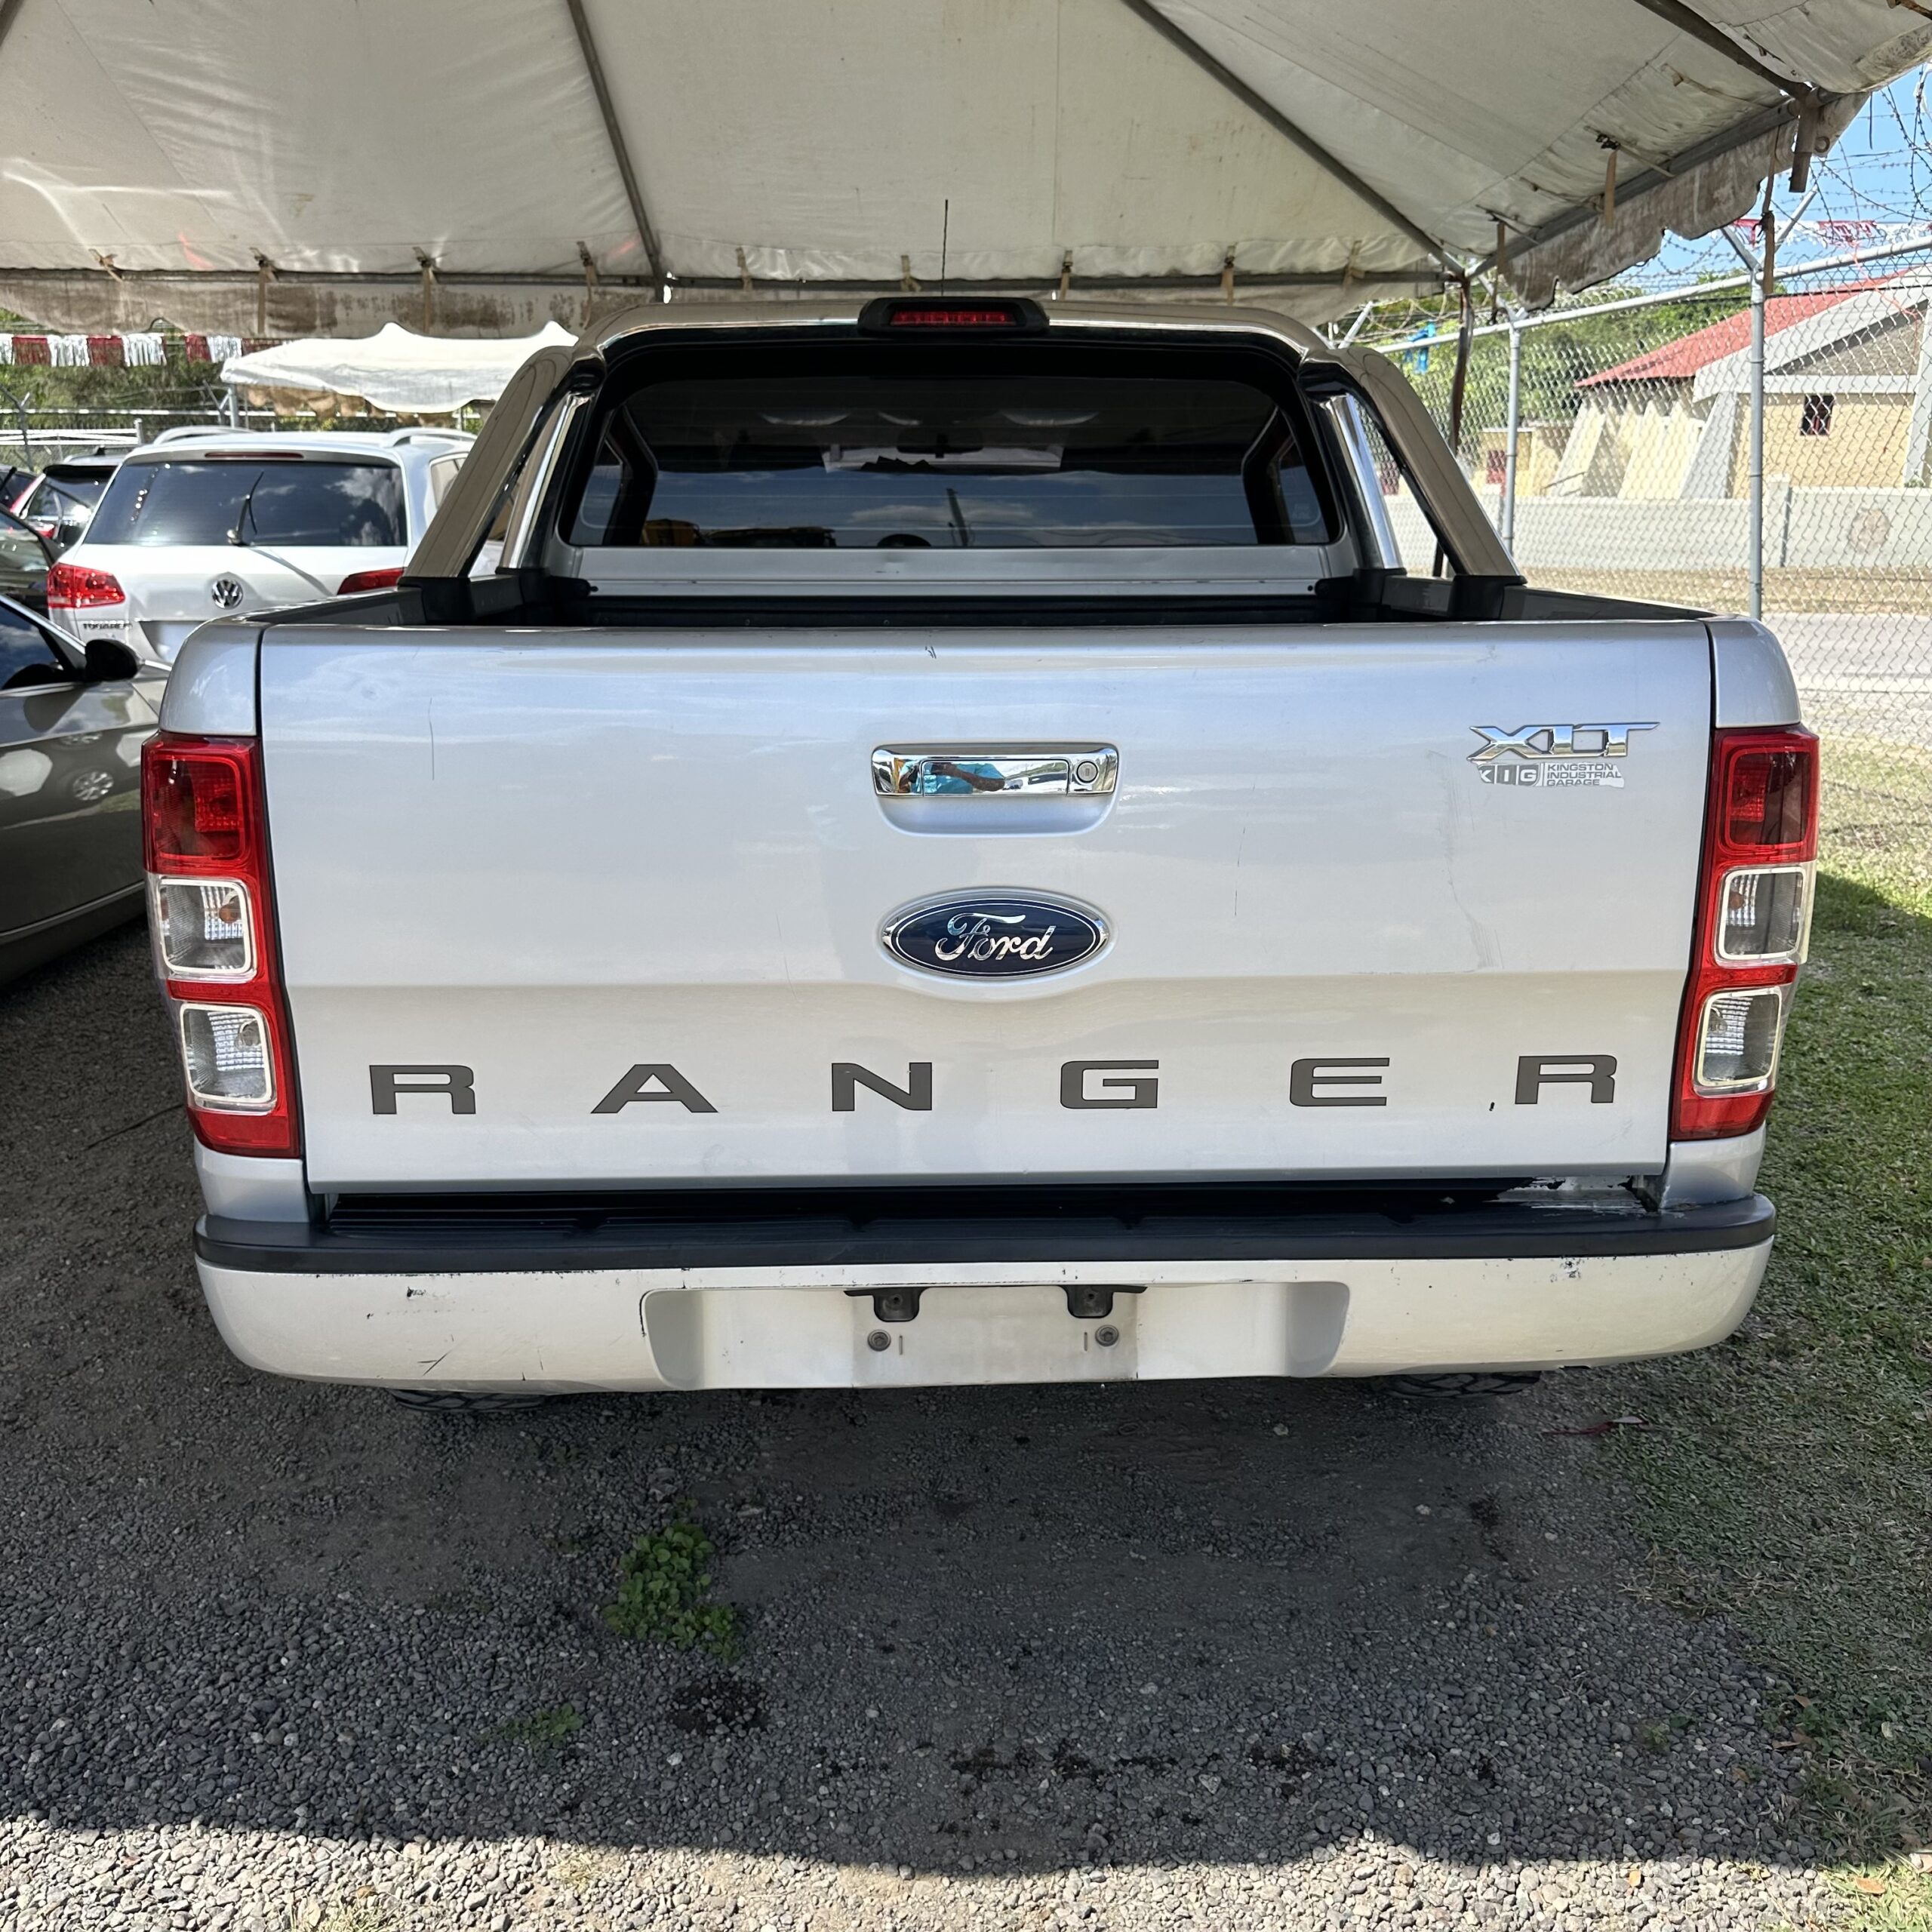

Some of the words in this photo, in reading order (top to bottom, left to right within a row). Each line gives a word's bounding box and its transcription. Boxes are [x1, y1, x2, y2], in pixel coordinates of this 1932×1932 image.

[1466, 722, 1660, 761] XLT
[934, 912, 1057, 961] Ford
[369, 1054, 1617, 1115] RANGER
